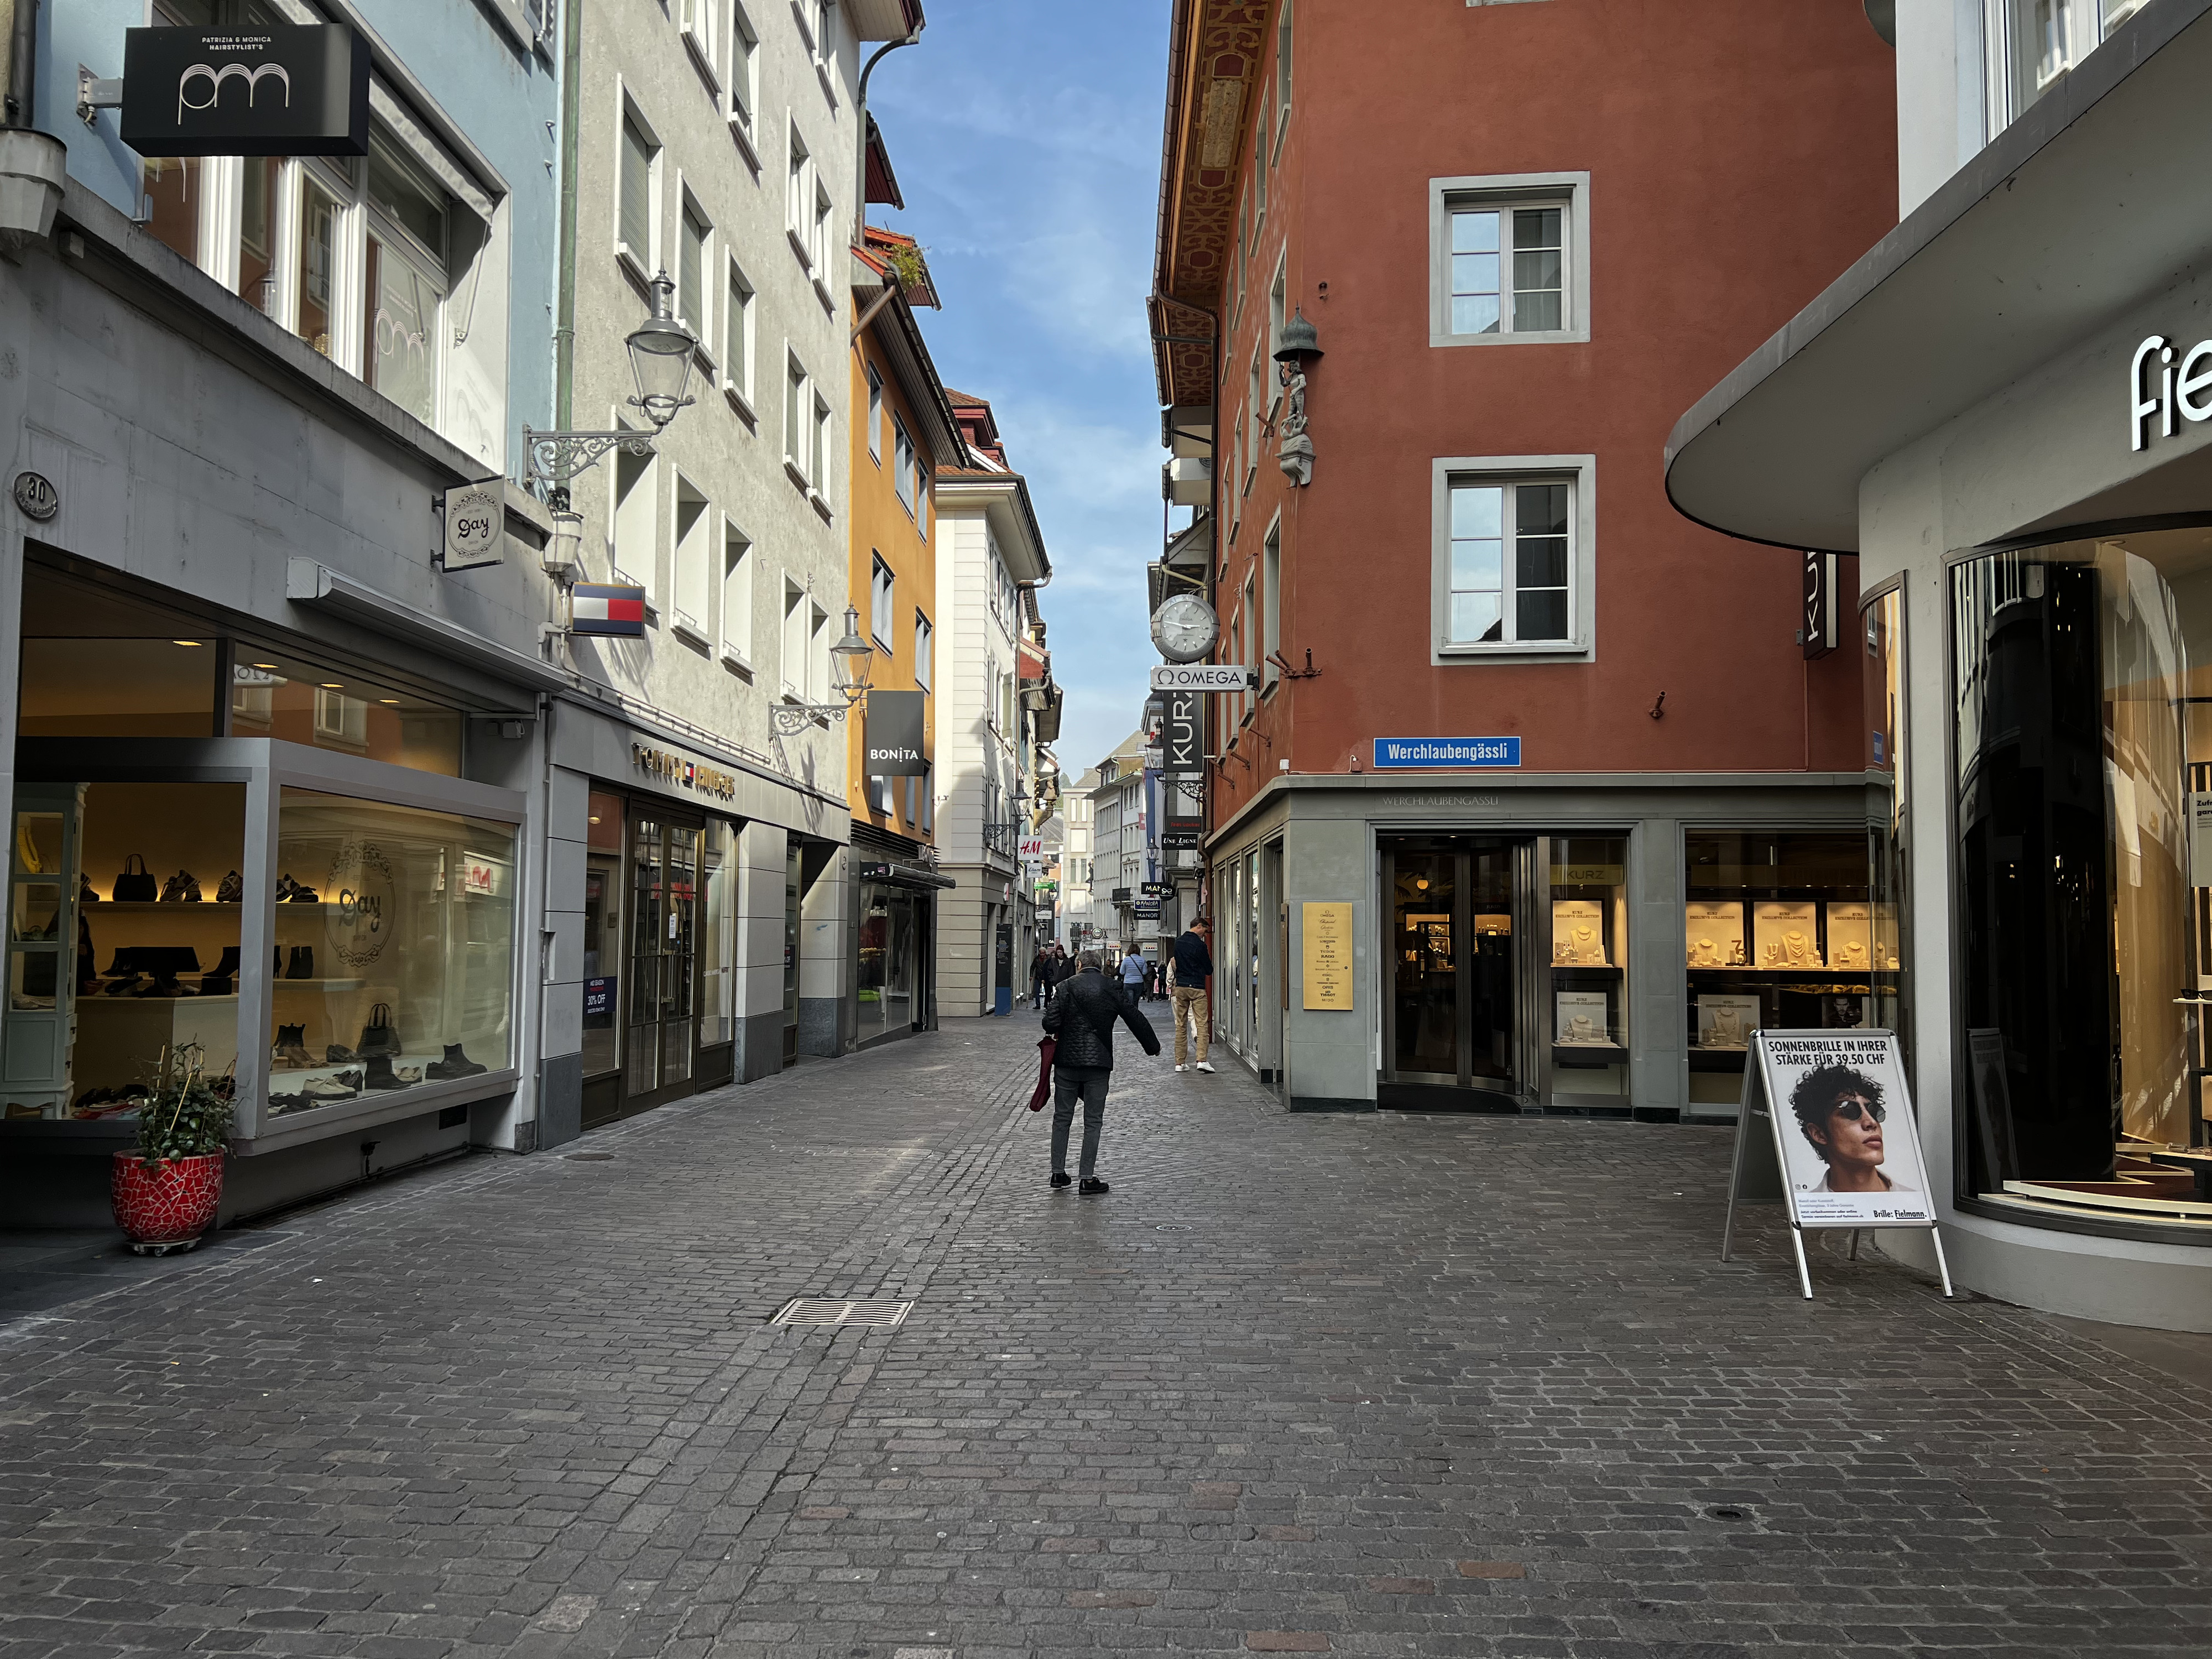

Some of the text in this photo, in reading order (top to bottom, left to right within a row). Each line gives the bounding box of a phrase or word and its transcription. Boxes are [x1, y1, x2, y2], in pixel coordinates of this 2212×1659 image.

[27, 477, 45, 503] 30
[1177, 671, 1242, 684] OMEGA
[1172, 692, 1193, 765] KUR
[1387, 742, 1507, 761] Werchlaubengässli
[1019, 840, 1041, 855] H&M
[1566, 870, 1605, 879] KURZ
[597, 993, 606, 1004] OFF
[1768, 1040, 1887, 1051] SONNENBRILLE IN IHRER
[1775, 1051, 1885, 1065] STÄRKE FÜR 39.50 CHF
[1873, 1209, 1927, 1218] Brille: Fielmann.
